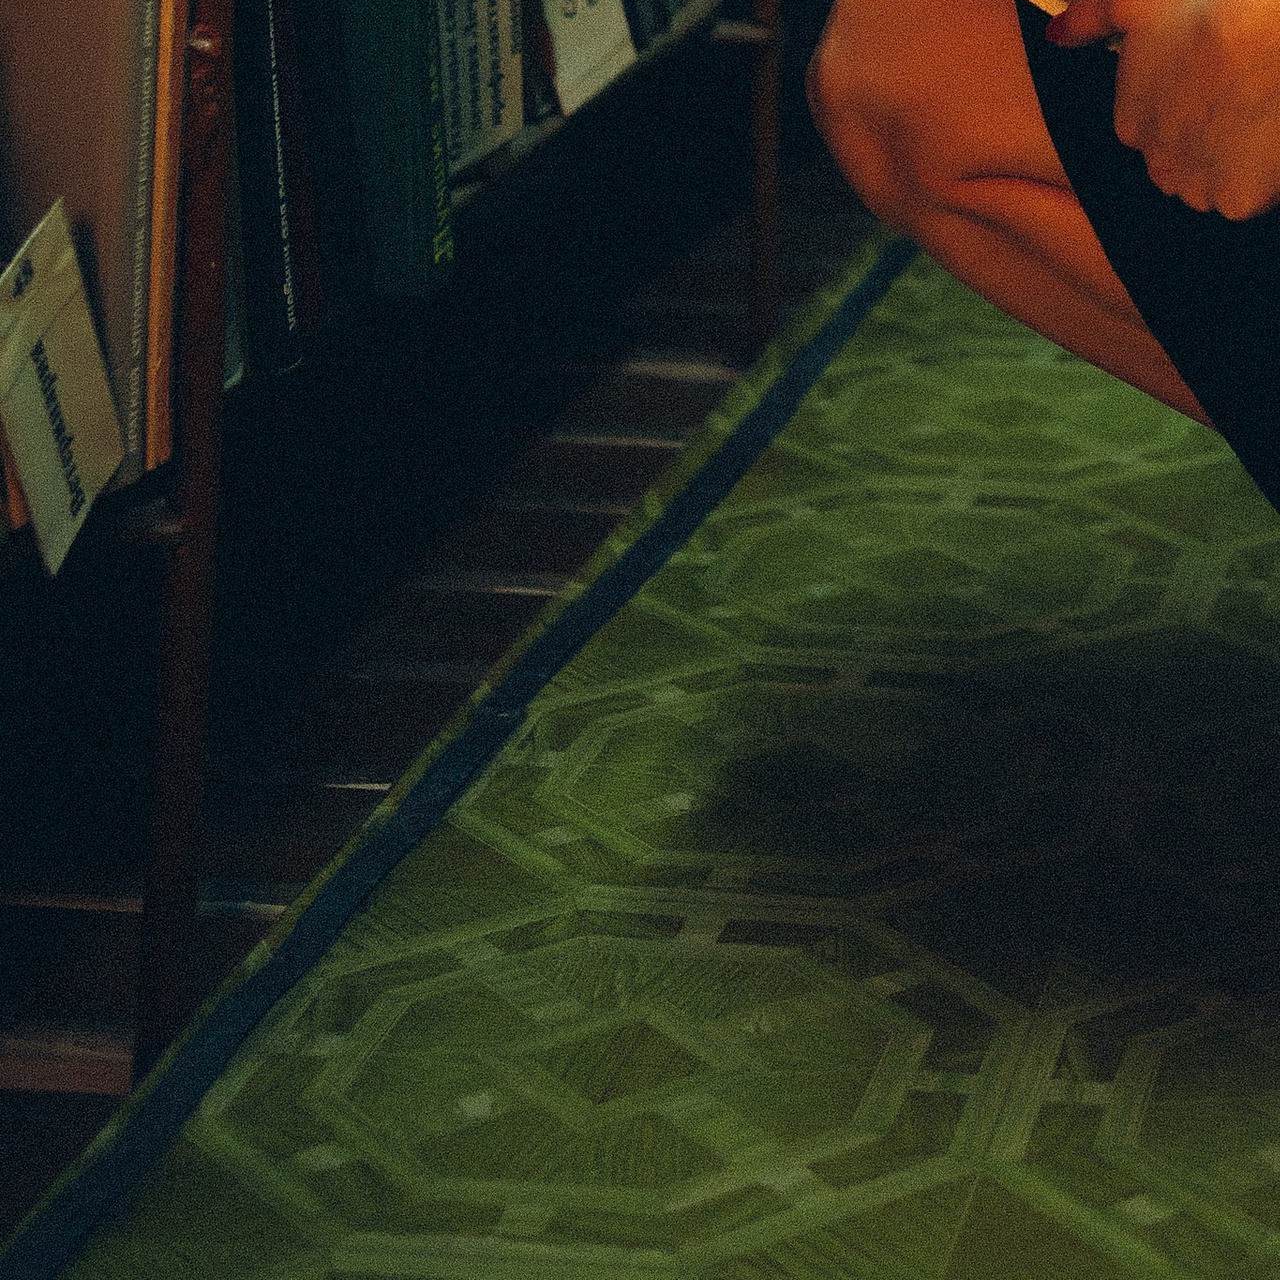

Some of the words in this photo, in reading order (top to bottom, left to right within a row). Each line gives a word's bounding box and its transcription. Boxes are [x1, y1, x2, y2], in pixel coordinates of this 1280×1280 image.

[136, 56, 153, 220] ВЕТЕРИНАРНОГО
[131, 226, 146, 357] СПРАВОЧНИК
[29, 337, 87, 518] Ветеринария
